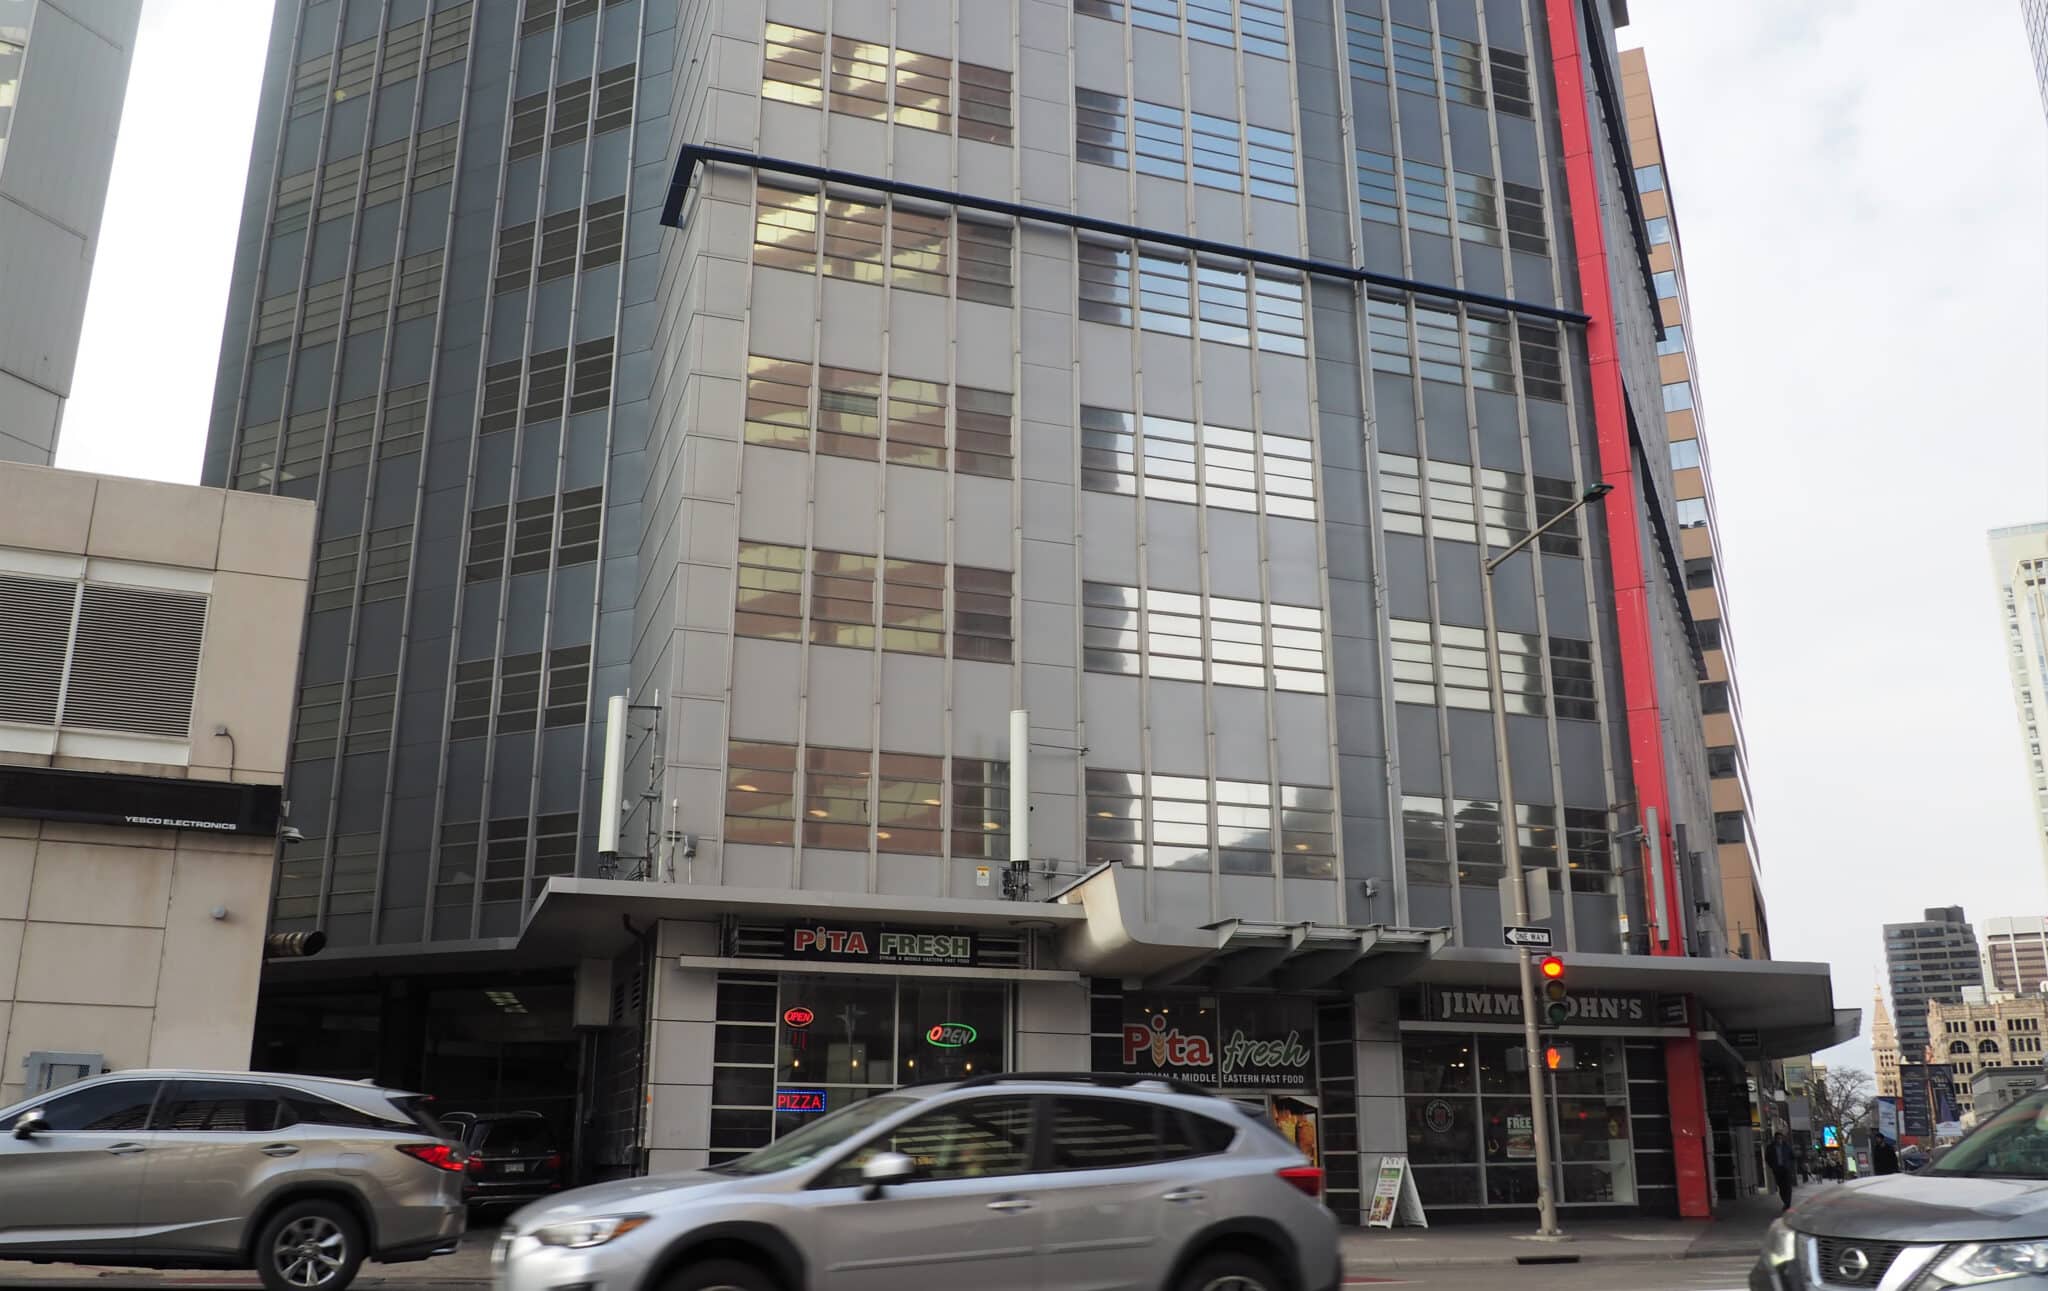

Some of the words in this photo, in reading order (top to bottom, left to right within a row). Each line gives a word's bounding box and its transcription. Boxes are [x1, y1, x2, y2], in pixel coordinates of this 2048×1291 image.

[125, 815, 162, 825] YESCO
[163, 818, 237, 830] ELECTRONICS
[879, 933, 970, 958] FRESH
[1440, 991, 1537, 1019] JIMM
[1560, 996, 1643, 1019] OHN'S
[787, 1011, 812, 1022] OPEN
[929, 1025, 971, 1045] OPEN
[1122, 1014, 1213, 1068] Pita
[1222, 1029, 1311, 1073] fresh
[1182, 1073, 1217, 1083] MIDDLE
[1223, 1074, 1259, 1084] EASTERN
[1261, 1074, 1280, 1084] FAST
[1282, 1075, 1304, 1084] FOOD
[777, 1095, 822, 1109] PIZZA
[1507, 1116, 1532, 1129] FREE
